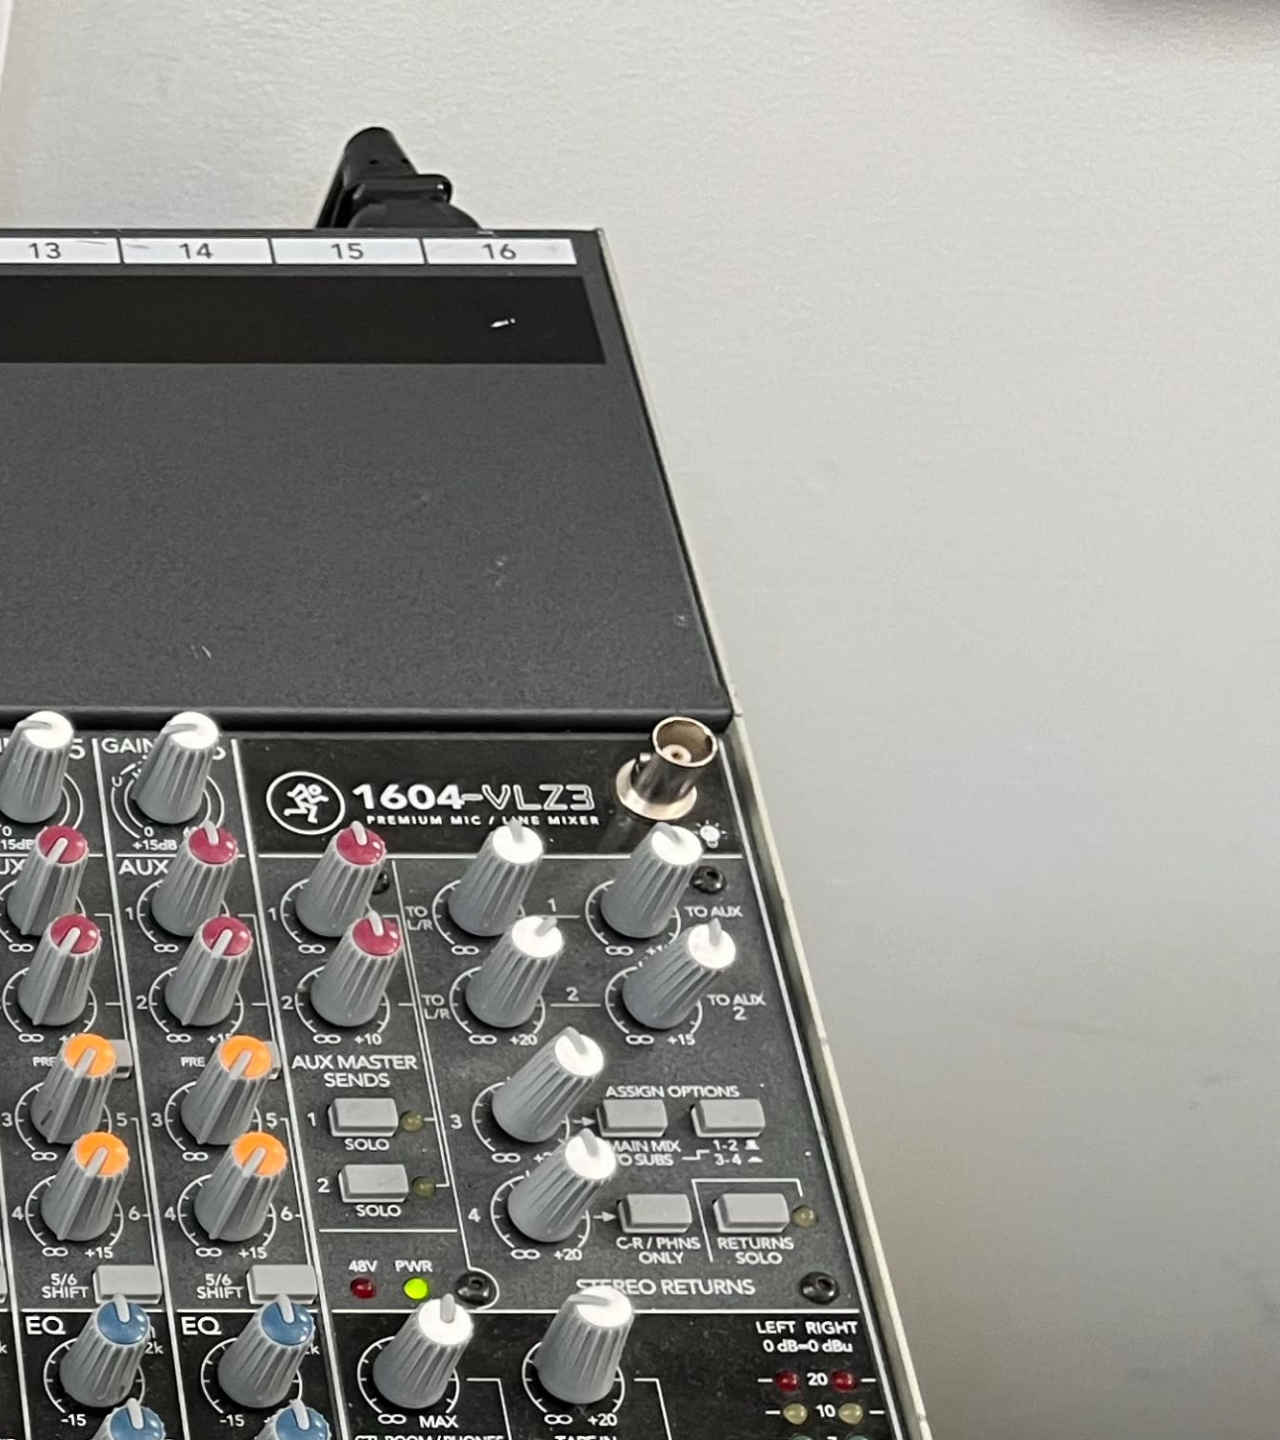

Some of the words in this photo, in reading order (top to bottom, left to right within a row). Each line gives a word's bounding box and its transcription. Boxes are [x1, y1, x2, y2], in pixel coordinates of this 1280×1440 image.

[30, 243, 61, 259] 13
[180, 243, 212, 259] 14
[332, 243, 363, 259] 15
[483, 244, 516, 259] 16
[353, 784, 594, 810] 1604-VLZ3
[367, 816, 442, 824] PREMIUM
[451, 816, 480, 825] MIC
[548, 816, 598, 824] MIXER
[685, 906, 703, 917] TO
[708, 906, 742, 917] AUX
[707, 994, 730, 1005] TO
[734, 994, 765, 1005] AUX
[733, 1006, 746, 1020] 2
[292, 1055, 329, 1069] AUX
[337, 1055, 417, 1069] MASTER
[324, 1073, 390, 1087] SENDS
[606, 1086, 664, 1097] ASSIGN
[668, 1086, 740, 1097] OPTIONS
[345, 1139, 389, 1150] SOLO
[651, 1141, 681, 1152] MIX
[714, 1140, 738, 1151] 1-2
[634, 1153, 674, 1166] SUBS
[715, 1154, 741, 1165] 3-4
[356, 1205, 401, 1216] SOLO
[616, 1237, 643, 1249] C-R
[656, 1237, 701, 1250] PHNS
[717, 1237, 794, 1249] RETURNS
[639, 1252, 683, 1264] ONLY
[736, 1252, 782, 1264] SOLO
[349, 1260, 377, 1272] 48V
[395, 1260, 432, 1272] PWR
[661, 1279, 755, 1294] RETURNS
[756, 1321, 795, 1333] LEFT
[806, 1321, 857, 1334] RIGHT
[763, 1340, 774, 1352] 0
[822, 1339, 852, 1352] dBu
[807, 1373, 828, 1385] 20
[816, 1405, 835, 1417] 10
[420, 1415, 458, 1428] MAX
